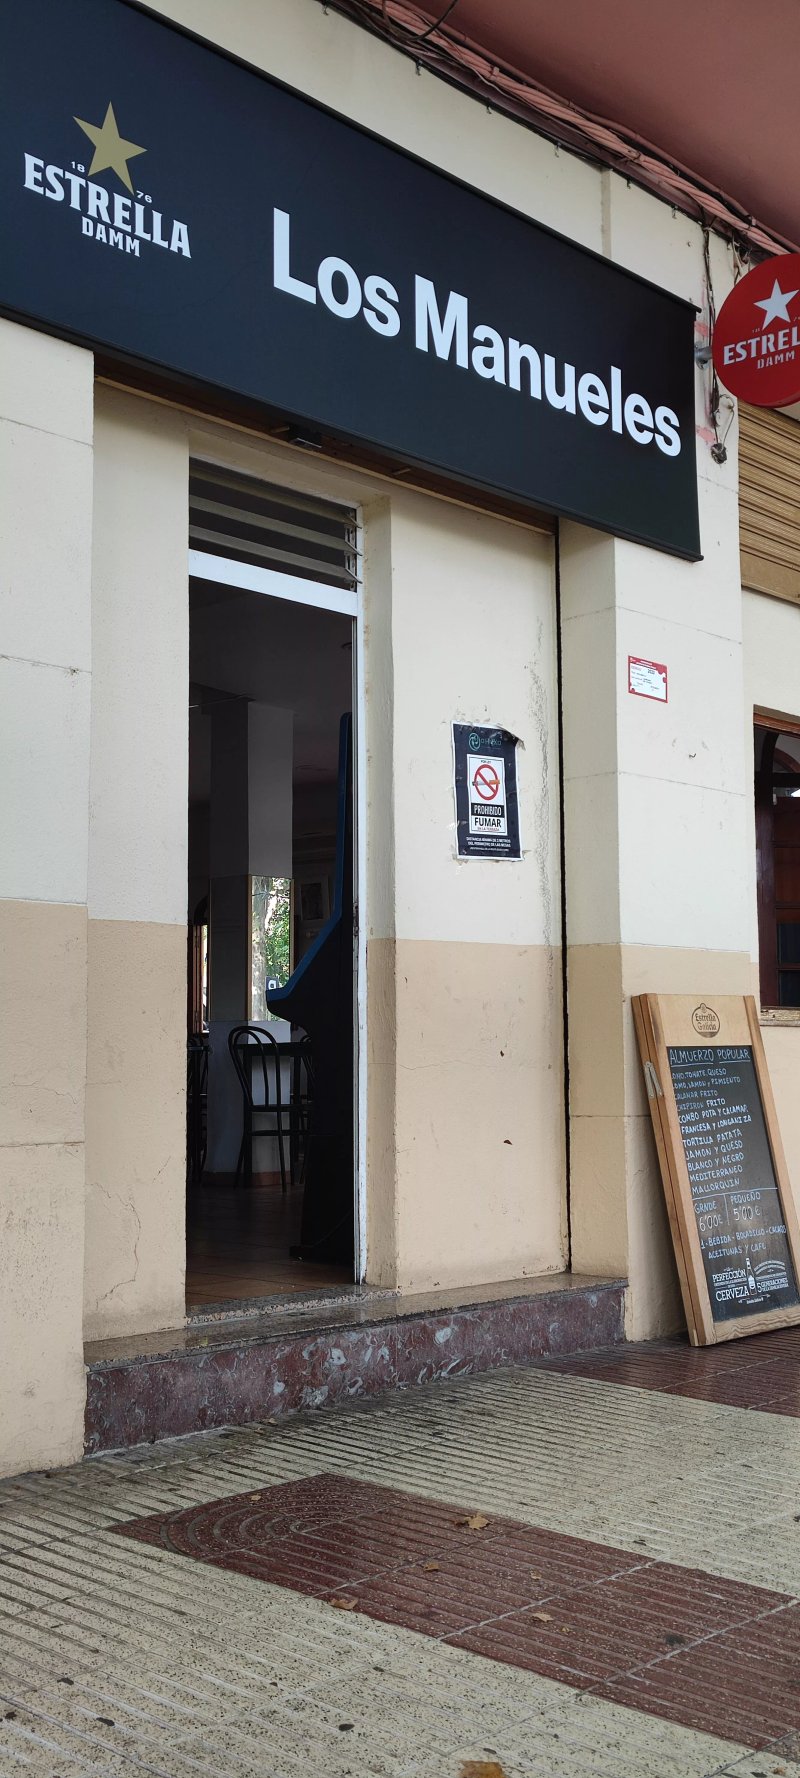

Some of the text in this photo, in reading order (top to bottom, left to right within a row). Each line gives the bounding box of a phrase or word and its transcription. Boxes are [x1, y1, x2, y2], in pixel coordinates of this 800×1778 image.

[71, 161, 85, 173] 18
[136, 190, 152, 203] 76
[24, 152, 191, 259] ESTRELLA
[81, 215, 140, 258] DAMM
[273, 207, 681, 457] Los Manueles
[757, 350, 795, 369] DAMM
[474, 805, 502, 816] PROHIBIDO
[475, 817, 502, 828] FUMAR
[695, 1013, 716, 1021] Estrella
[670, 1049, 750, 1064] ALMUERZO POPULAR
[706, 1098, 726, 1107] FRITO
[678, 1112, 700, 1124] COMBO
[702, 1110, 717, 1118] POTA
[717, 1108, 721, 1116] Y
[681, 1122, 711, 1135] FRANCESA
[682, 1128, 743, 1148] TORTILLA PATATA
[685, 1140, 743, 1160] JAMON Y QUESO
[687, 1152, 744, 1172] BLANCO Y NEGRO
[689, 1165, 743, 1182] MEDITERRANEO
[692, 1178, 740, 1195] MALLORQUIN
[708, 1246, 743, 1259] ACEITUNAS
[715, 1286, 750, 1302] CERVEZA
[756, 1282, 762, 1293] 5
